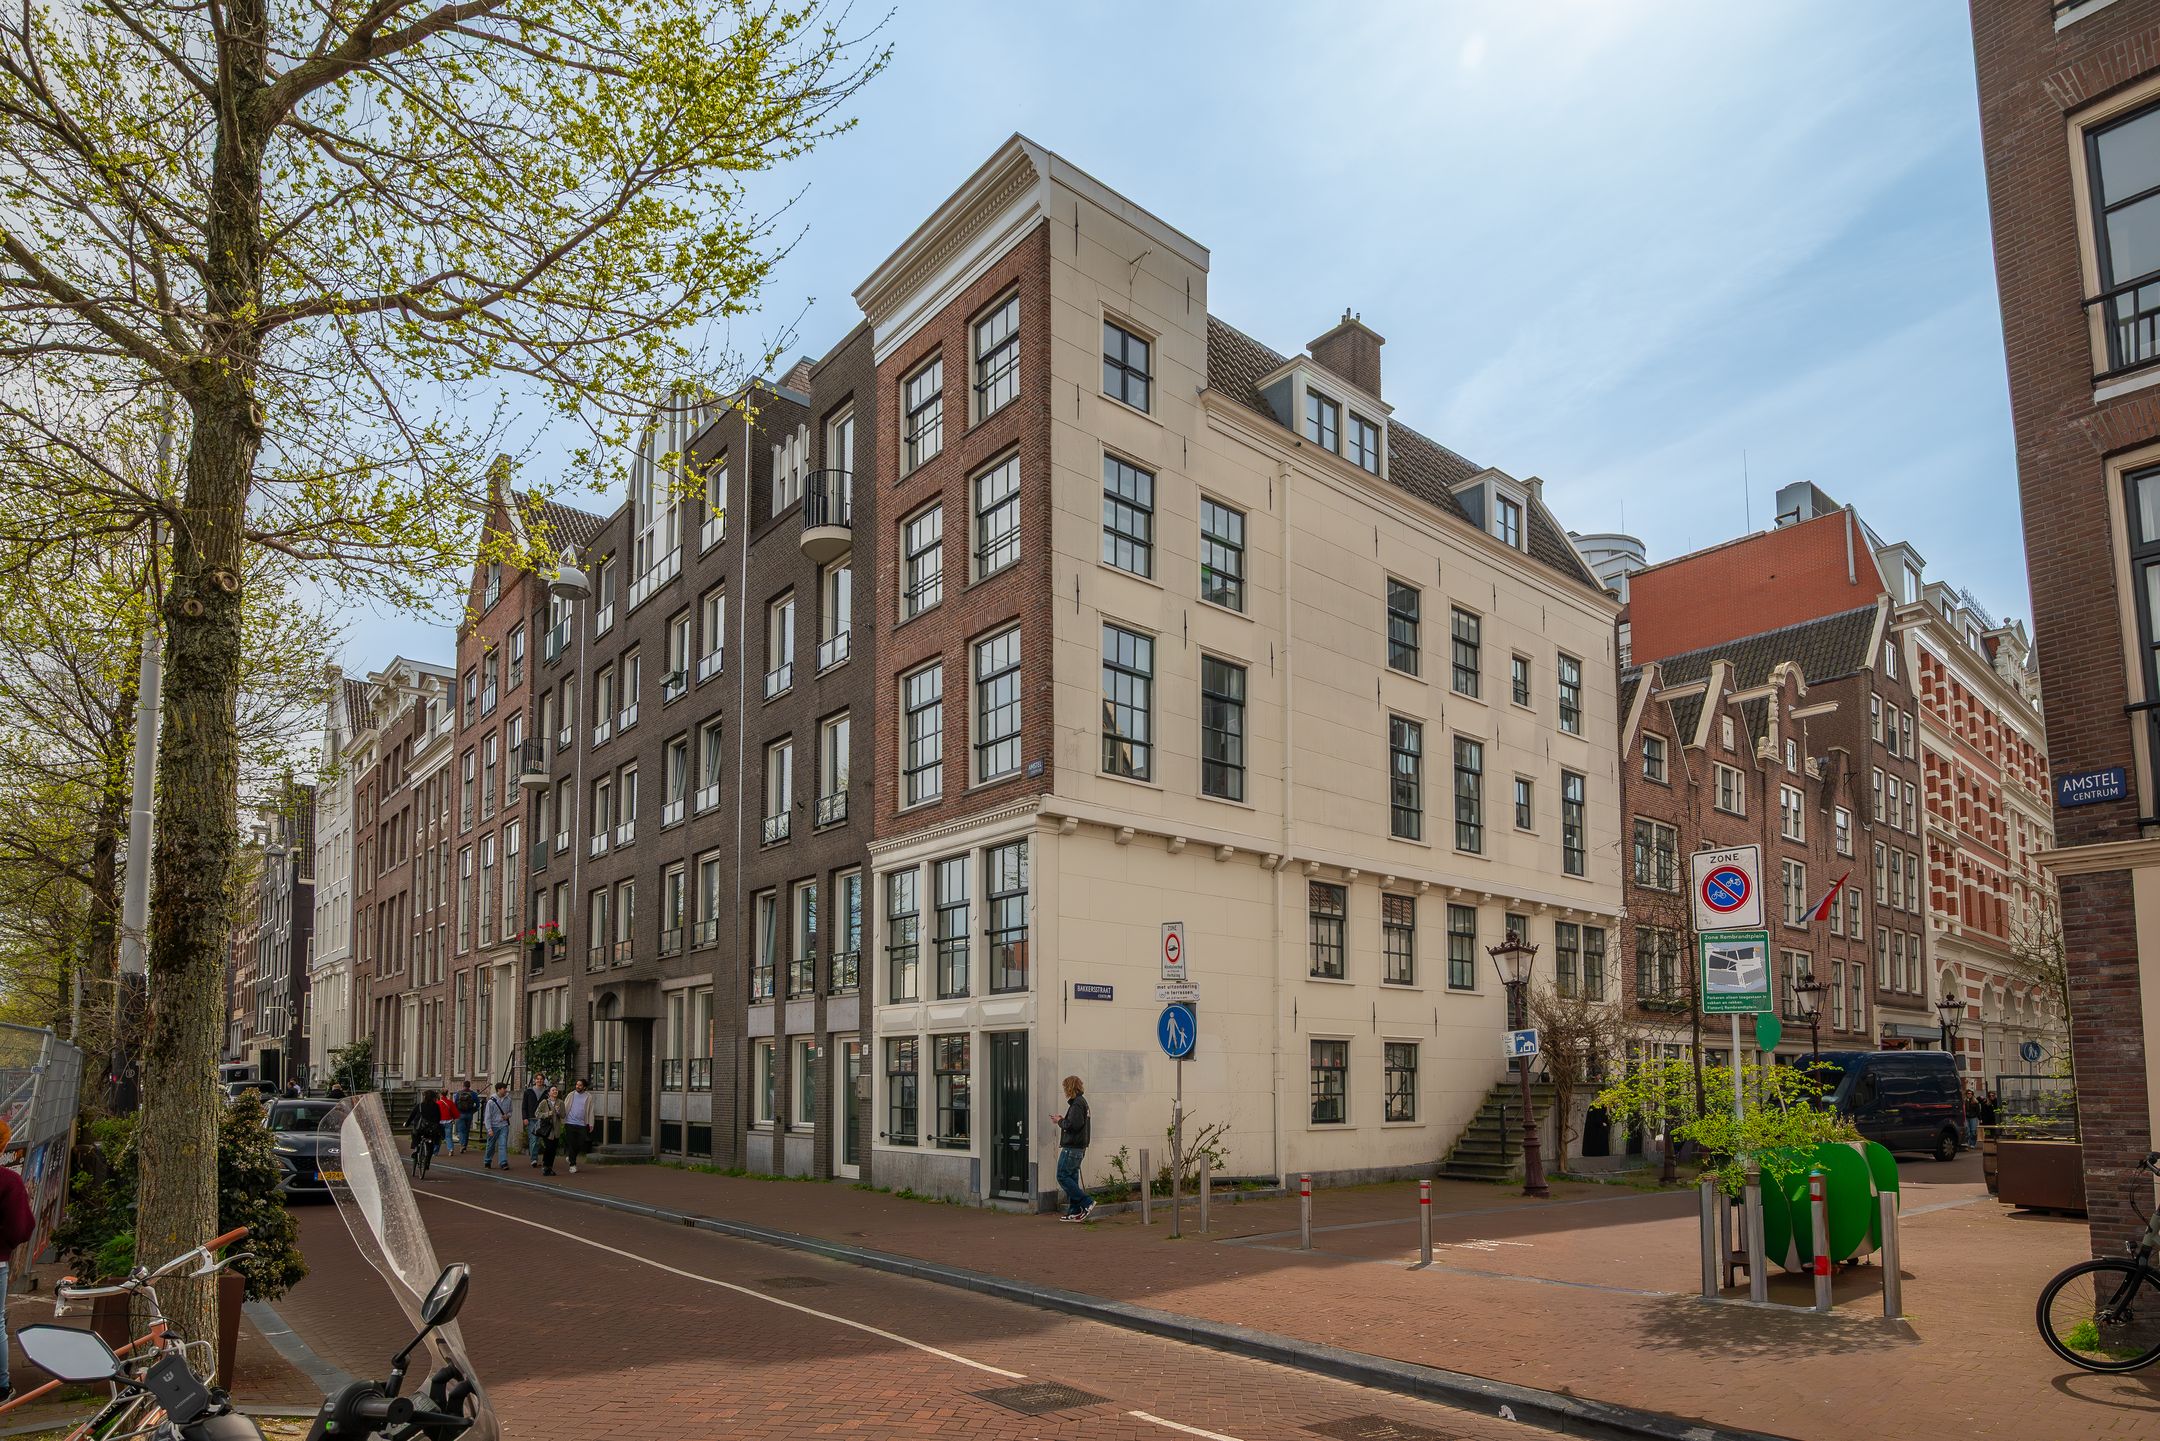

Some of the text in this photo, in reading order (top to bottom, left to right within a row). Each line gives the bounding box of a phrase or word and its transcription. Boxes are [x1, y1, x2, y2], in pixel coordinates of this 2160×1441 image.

[2063, 772, 2119, 793] AMSTEL
[2073, 787, 2119, 801] CENTRUM
[1710, 853, 1740, 864] ZONE
[1077, 985, 1112, 994] BAKKERSSTRAAT
